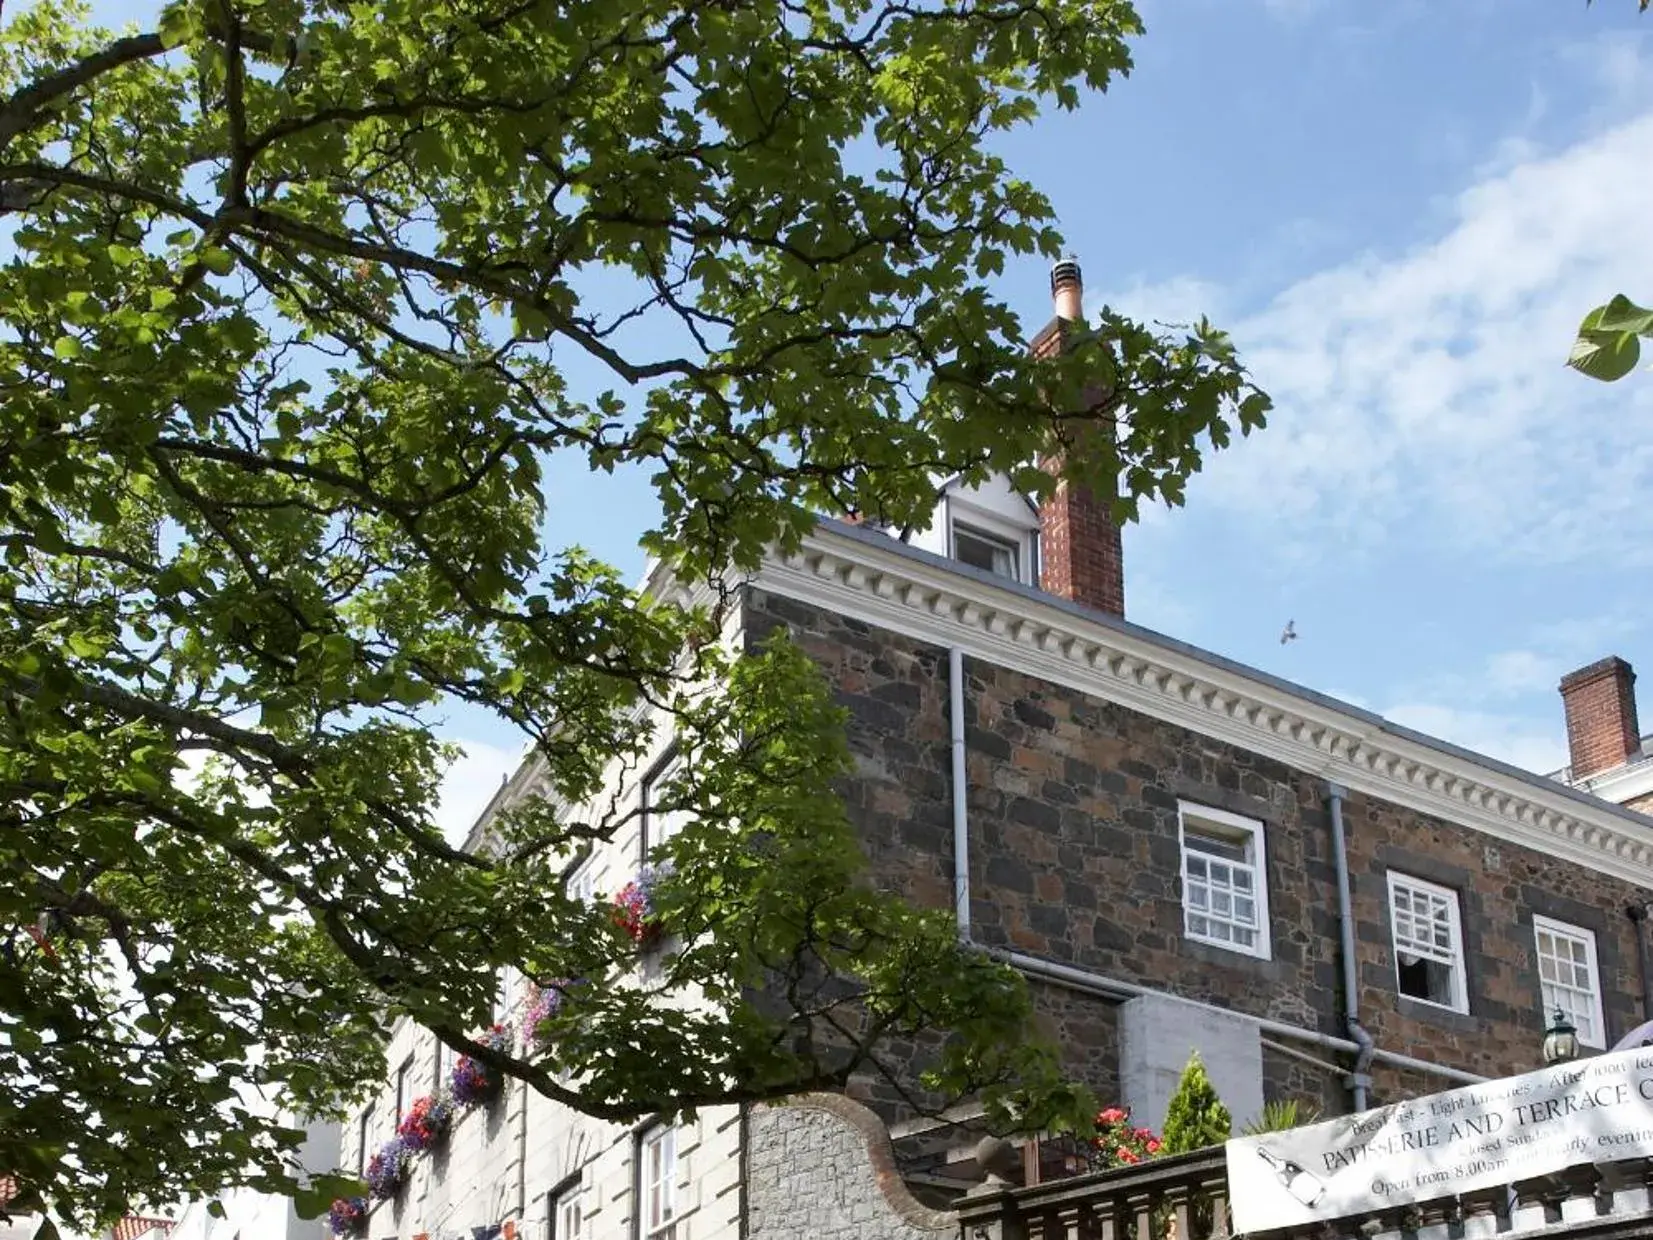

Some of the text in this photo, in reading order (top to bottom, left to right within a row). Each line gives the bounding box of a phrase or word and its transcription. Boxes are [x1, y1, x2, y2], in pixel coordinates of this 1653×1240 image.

[1322, 1125, 1439, 1171] PATISSERIE
[1447, 1111, 1503, 1142] AND
[1511, 1083, 1628, 1127] TERRACE
[1350, 1107, 1415, 1136] Breaast
[1430, 1095, 1464, 1117] Light
[1470, 1082, 1530, 1107] Luhes
[1371, 1177, 1409, 1197] Open
[1415, 1170, 1449, 1186] from
